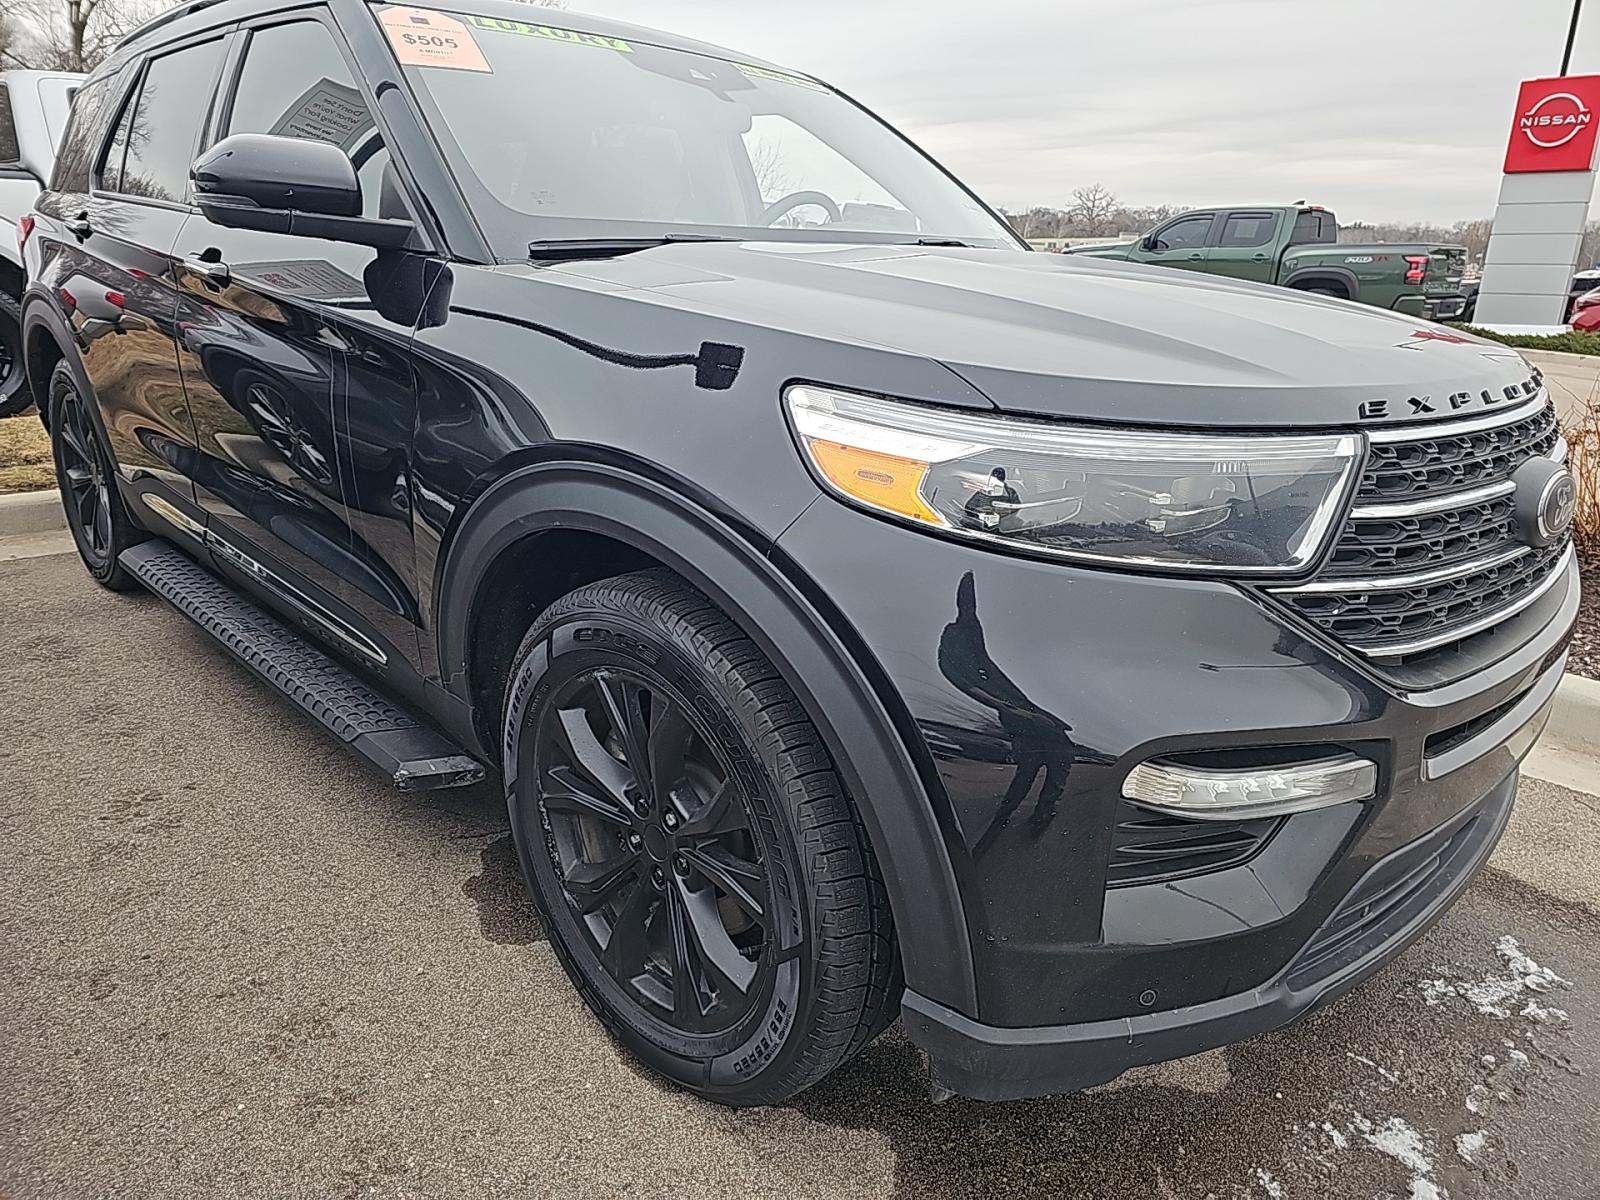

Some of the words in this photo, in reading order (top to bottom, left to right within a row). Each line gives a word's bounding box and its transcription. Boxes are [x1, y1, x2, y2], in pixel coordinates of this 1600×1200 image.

[402, 33, 458, 49] $505
[474, 16, 617, 47] LUXURY
[1520, 114, 1590, 127] NISSAN
[573, 627, 662, 665] EDGE
